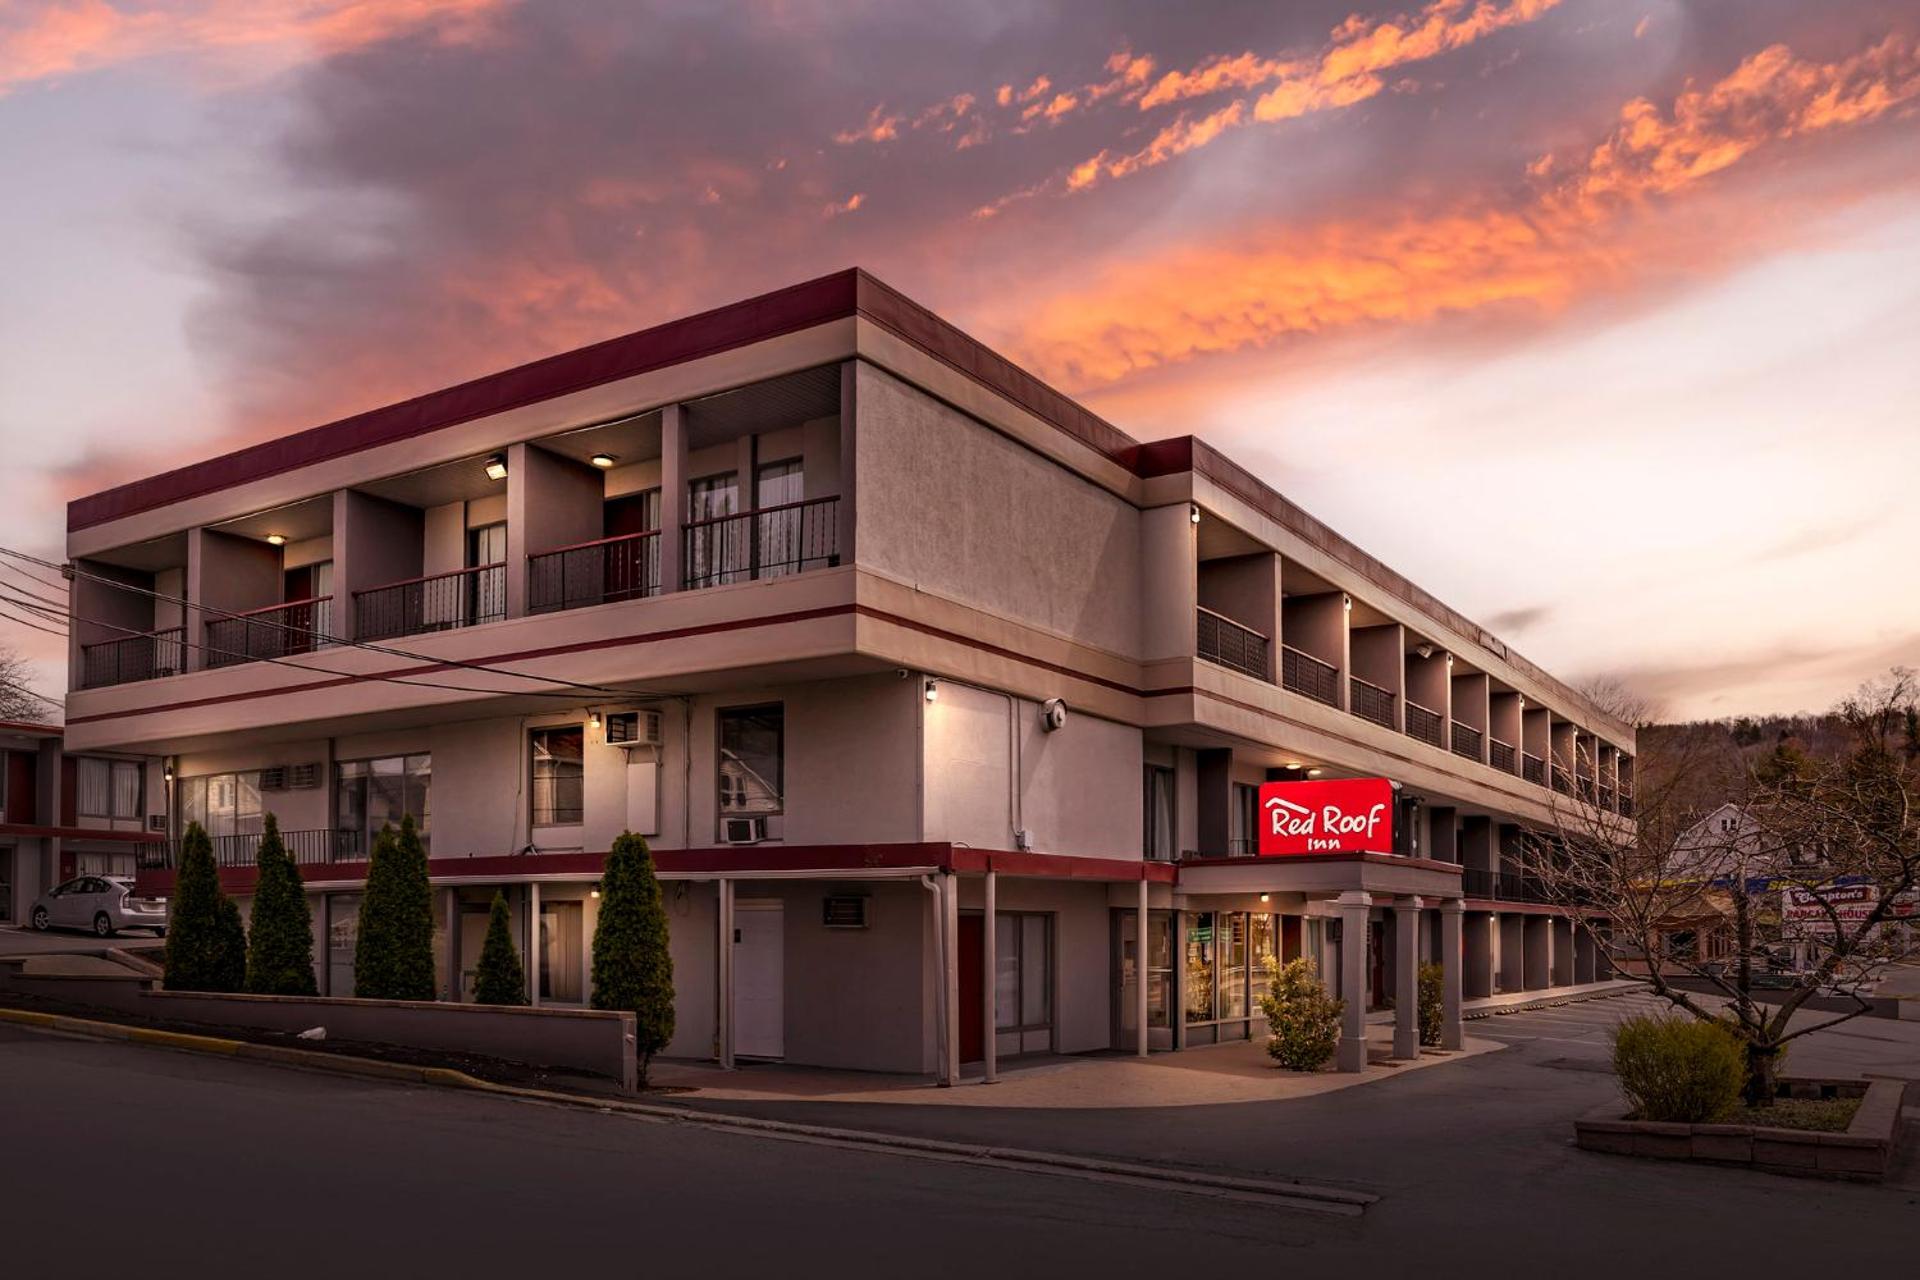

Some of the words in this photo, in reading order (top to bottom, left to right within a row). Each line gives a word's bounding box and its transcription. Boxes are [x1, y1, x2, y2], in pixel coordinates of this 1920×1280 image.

[1272, 807, 1315, 837] Red
[1322, 803, 1386, 838] Roof
[1307, 838, 1341, 851] Inn
